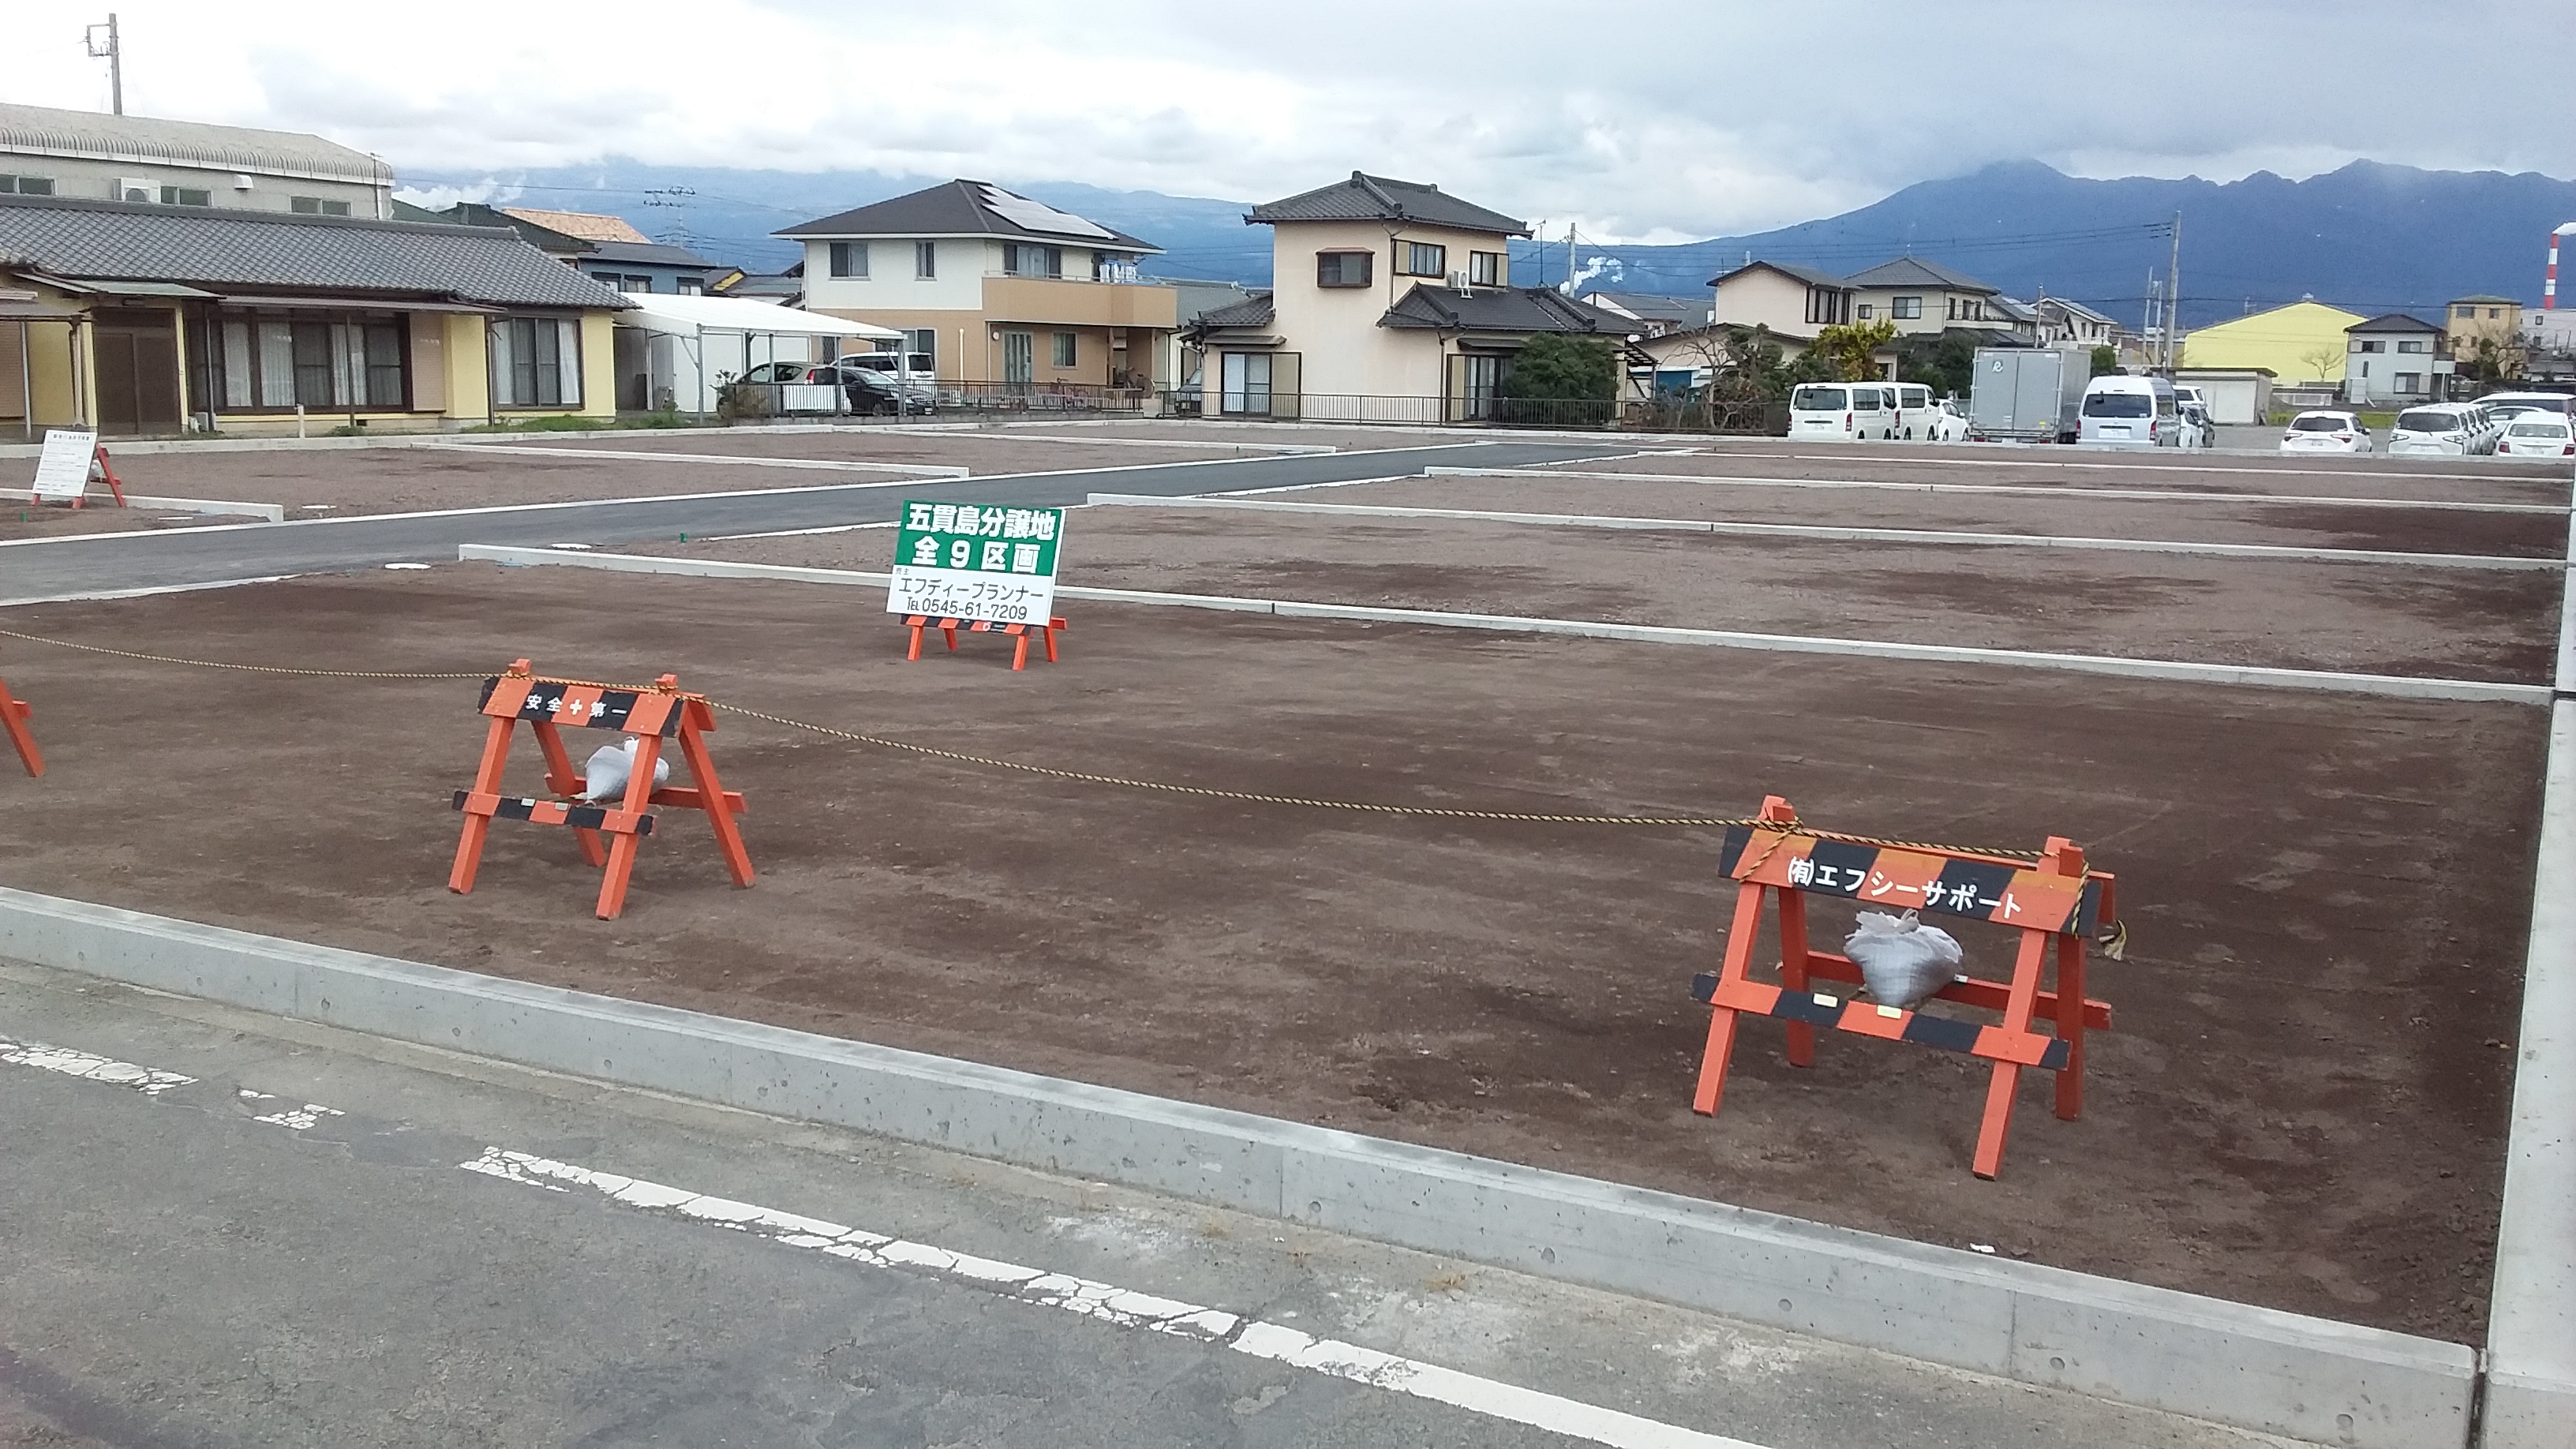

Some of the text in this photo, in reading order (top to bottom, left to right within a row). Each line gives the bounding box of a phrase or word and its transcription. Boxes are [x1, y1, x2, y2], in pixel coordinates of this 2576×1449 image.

[906, 503, 1056, 541] 五貫島分譲地
[899, 578, 1044, 602] エフディープランナー
[922, 598, 1028, 620] 0545-61-7209
